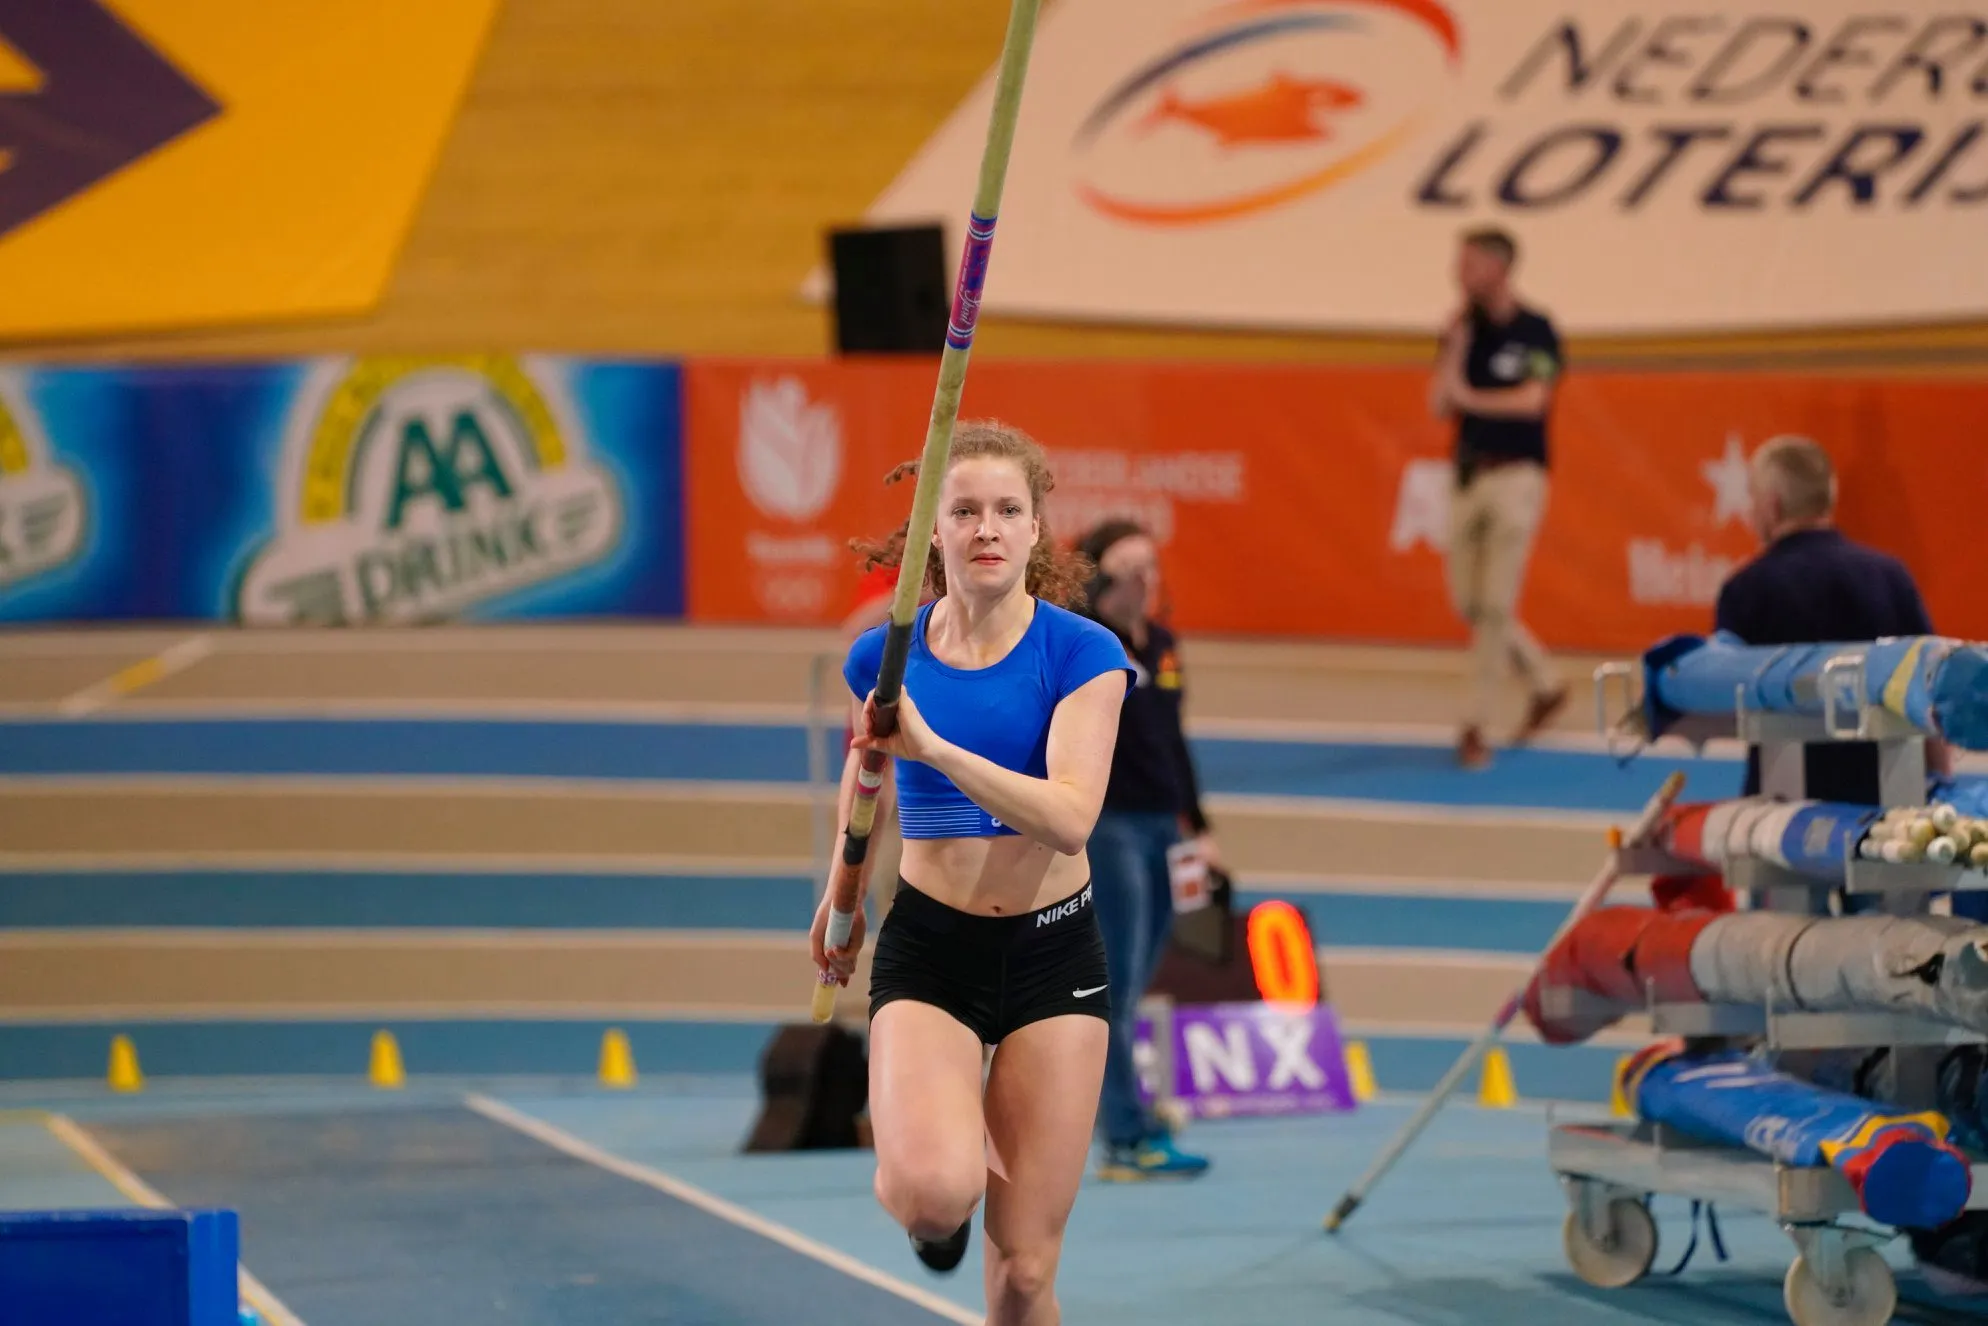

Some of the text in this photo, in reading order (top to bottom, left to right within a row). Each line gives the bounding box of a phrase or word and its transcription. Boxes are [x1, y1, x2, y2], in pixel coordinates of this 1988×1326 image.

[387, 411, 513, 530] AA
[1035, 883, 1092, 928] NIKE PR
[1248, 901, 1319, 1014] 0
